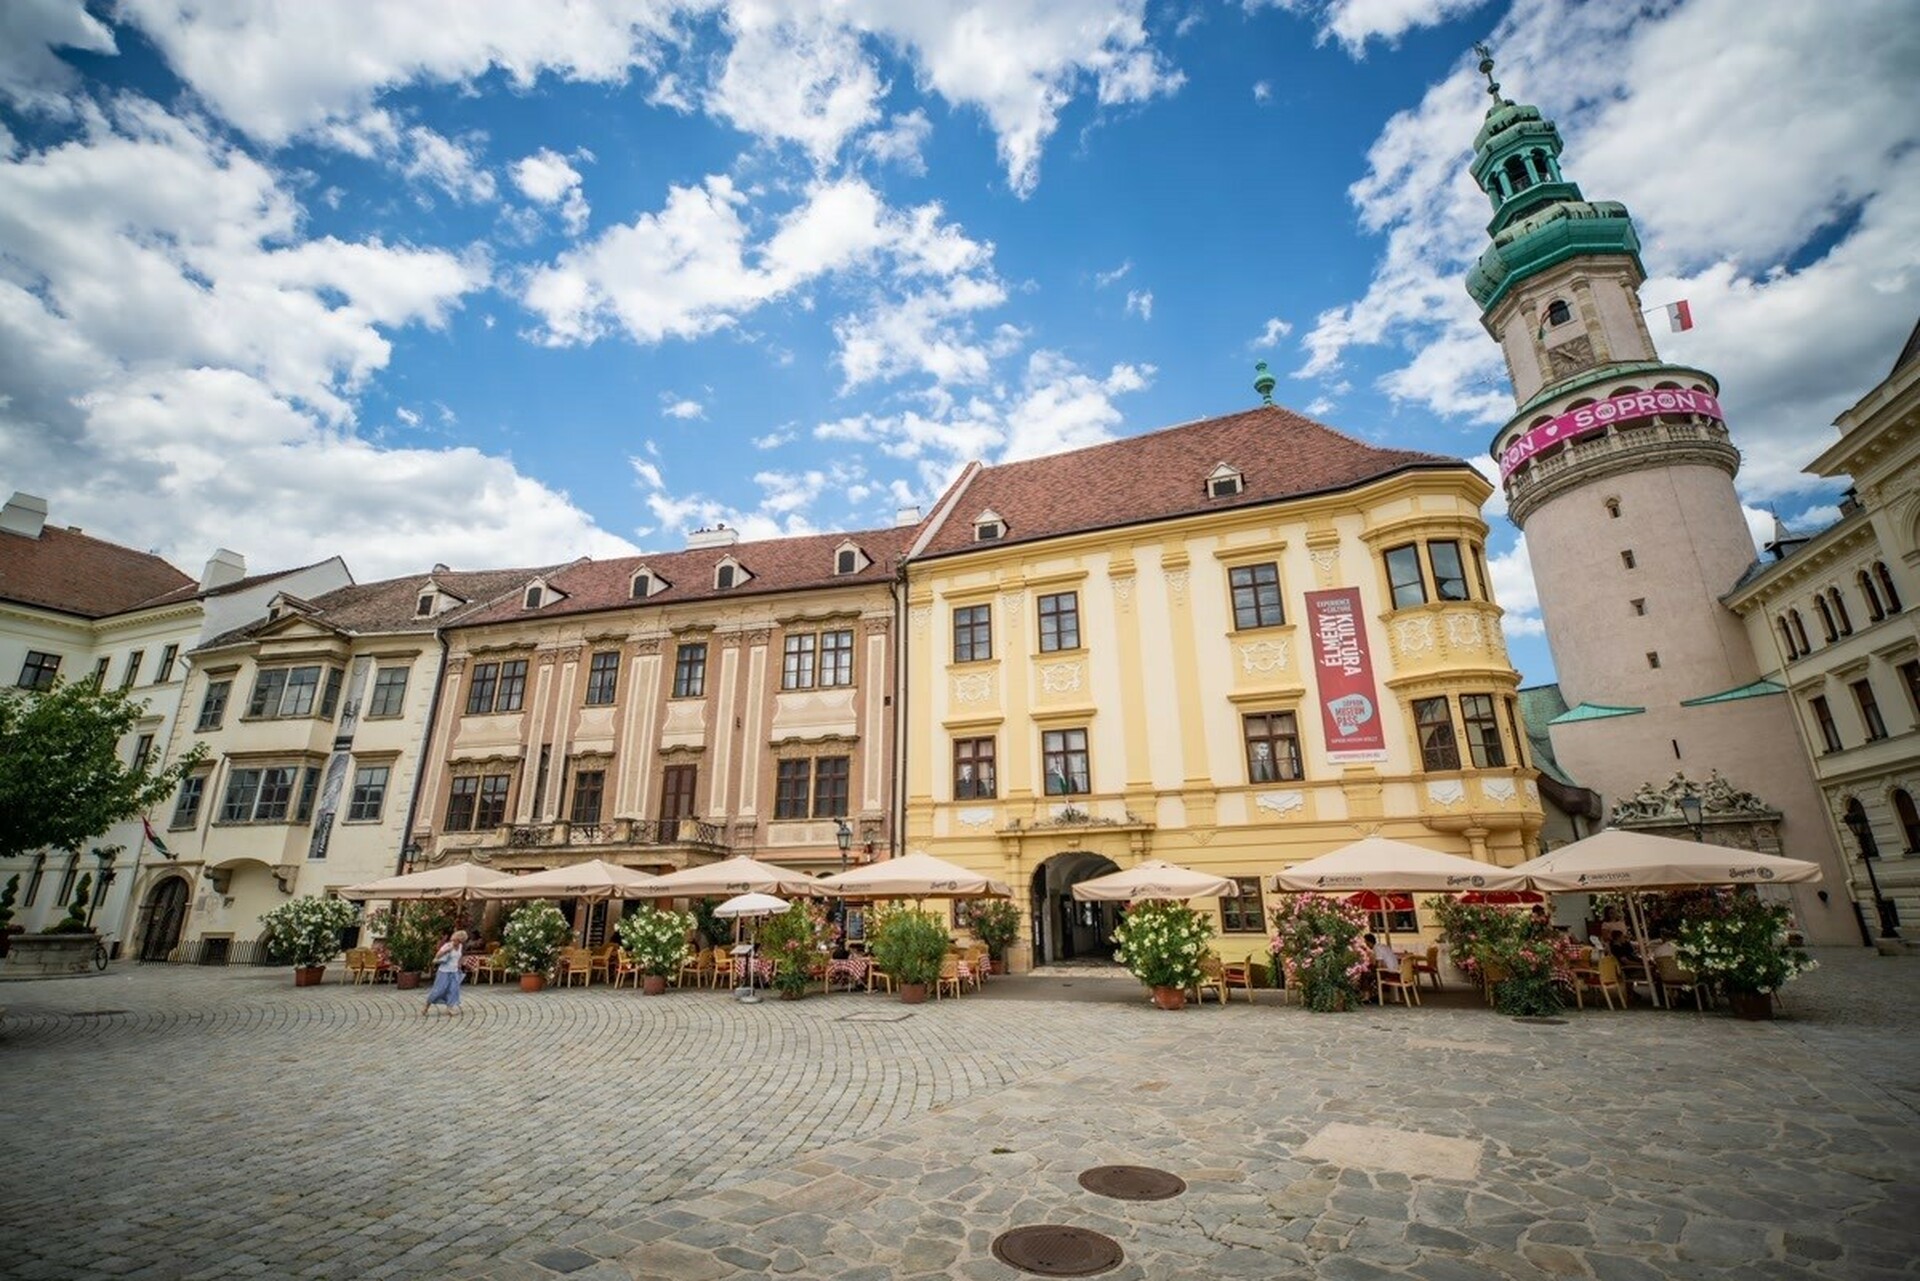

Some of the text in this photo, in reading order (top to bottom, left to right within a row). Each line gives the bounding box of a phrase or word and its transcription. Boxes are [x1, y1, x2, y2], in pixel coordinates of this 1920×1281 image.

[1575, 393, 1696, 428] SOPRON
[1316, 614, 1343, 667] ÉLMÉNY
[1336, 613, 1363, 676] KULTÚRA
